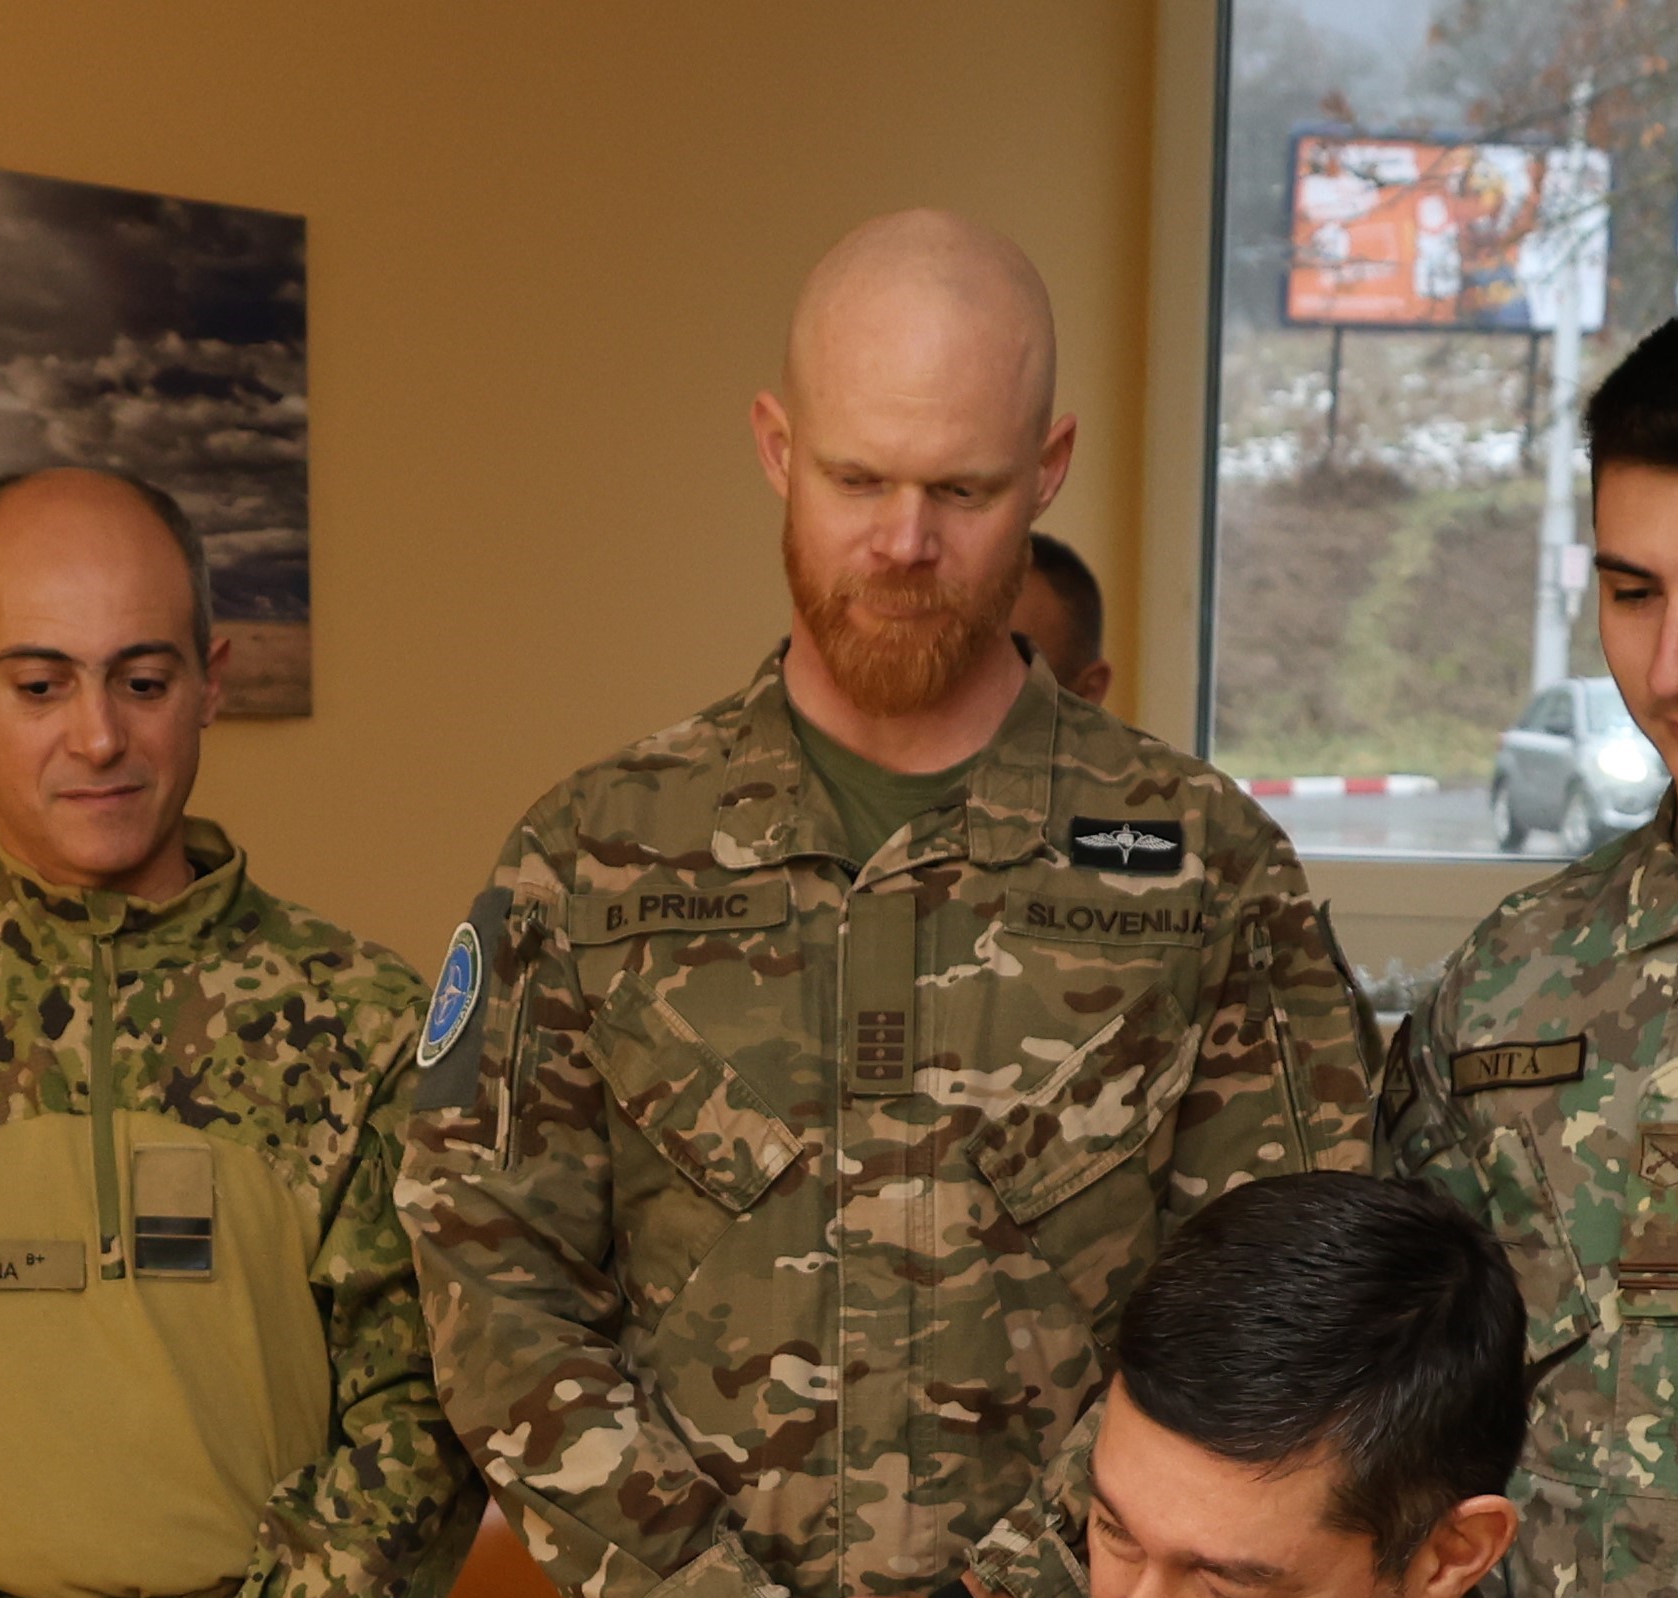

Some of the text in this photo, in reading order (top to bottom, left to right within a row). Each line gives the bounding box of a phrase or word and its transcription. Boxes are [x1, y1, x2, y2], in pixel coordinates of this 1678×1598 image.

[606, 893, 749, 931] B. PRIMC
[25, 1252, 46, 1266] B+
